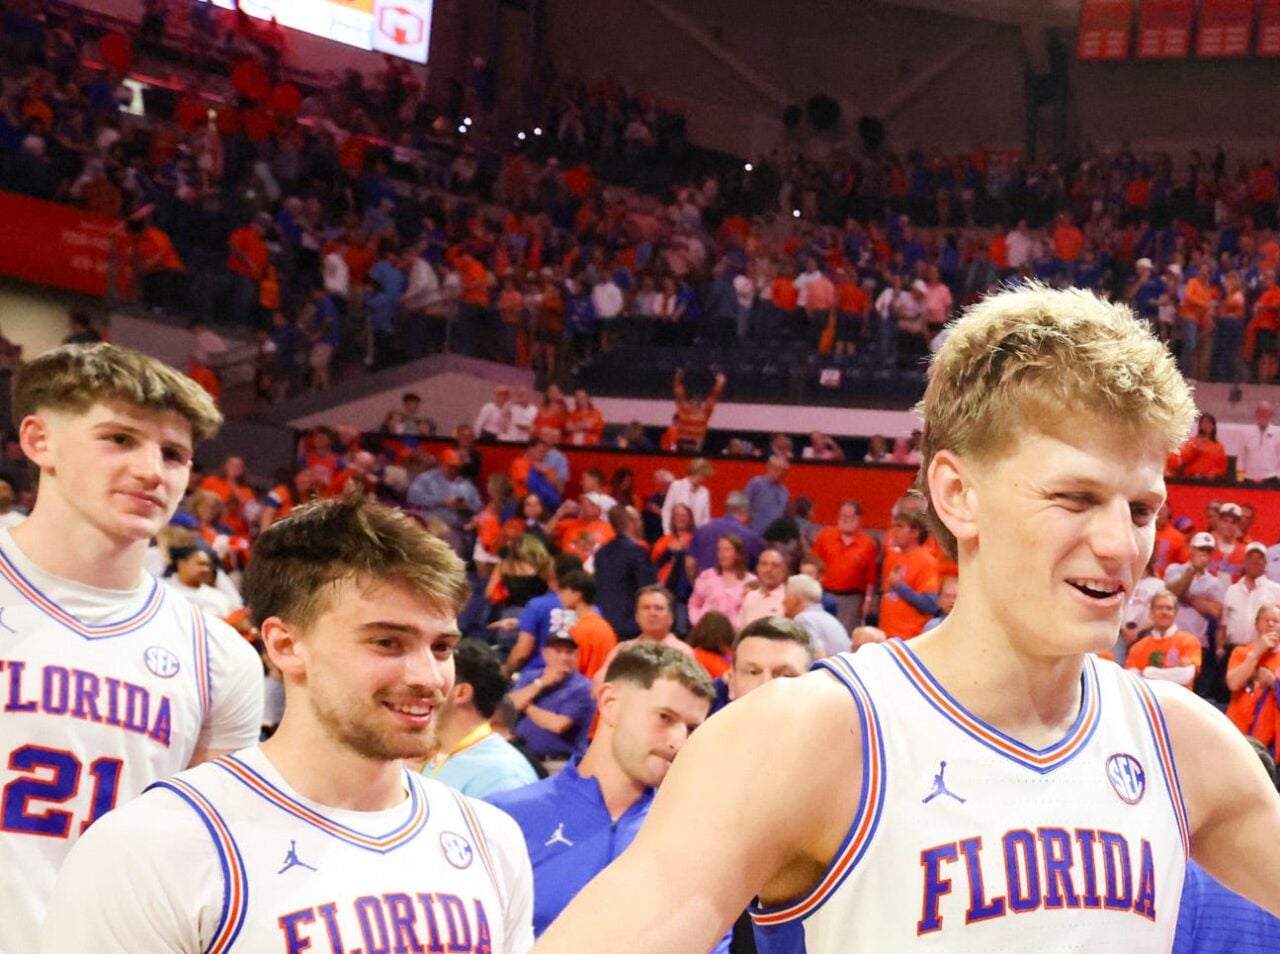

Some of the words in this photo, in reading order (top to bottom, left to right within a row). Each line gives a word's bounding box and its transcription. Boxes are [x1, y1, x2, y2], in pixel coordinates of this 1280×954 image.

[0, 660, 173, 749] LORIDA
[0, 744, 124, 840] 21
[1106, 753, 1146, 806] SEC
[916, 826, 1157, 937] FLORIDA
